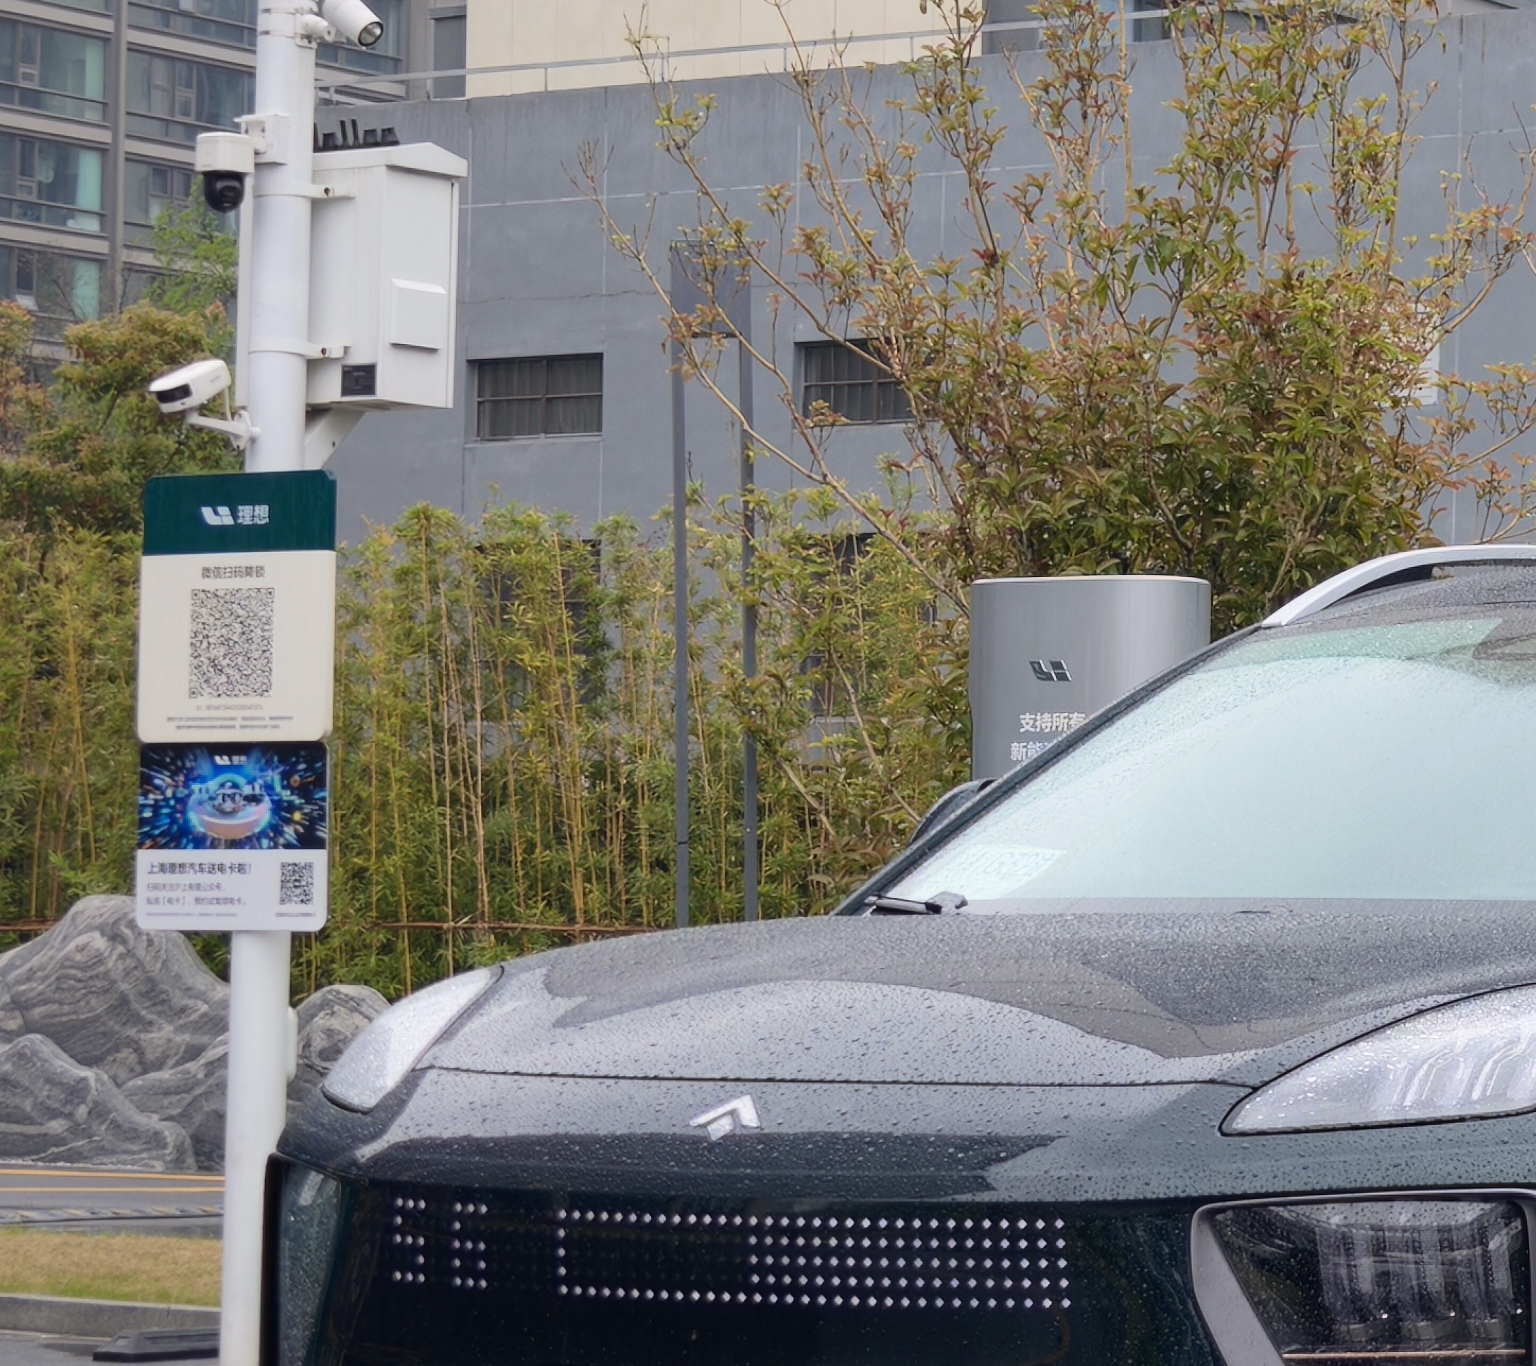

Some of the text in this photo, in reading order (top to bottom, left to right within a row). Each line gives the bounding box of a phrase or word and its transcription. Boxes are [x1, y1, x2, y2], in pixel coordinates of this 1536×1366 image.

[237, 504, 270, 525] 理想
[1019, 712, 1086, 733] 支持所有
[1010, 741, 1049, 761] 新能
